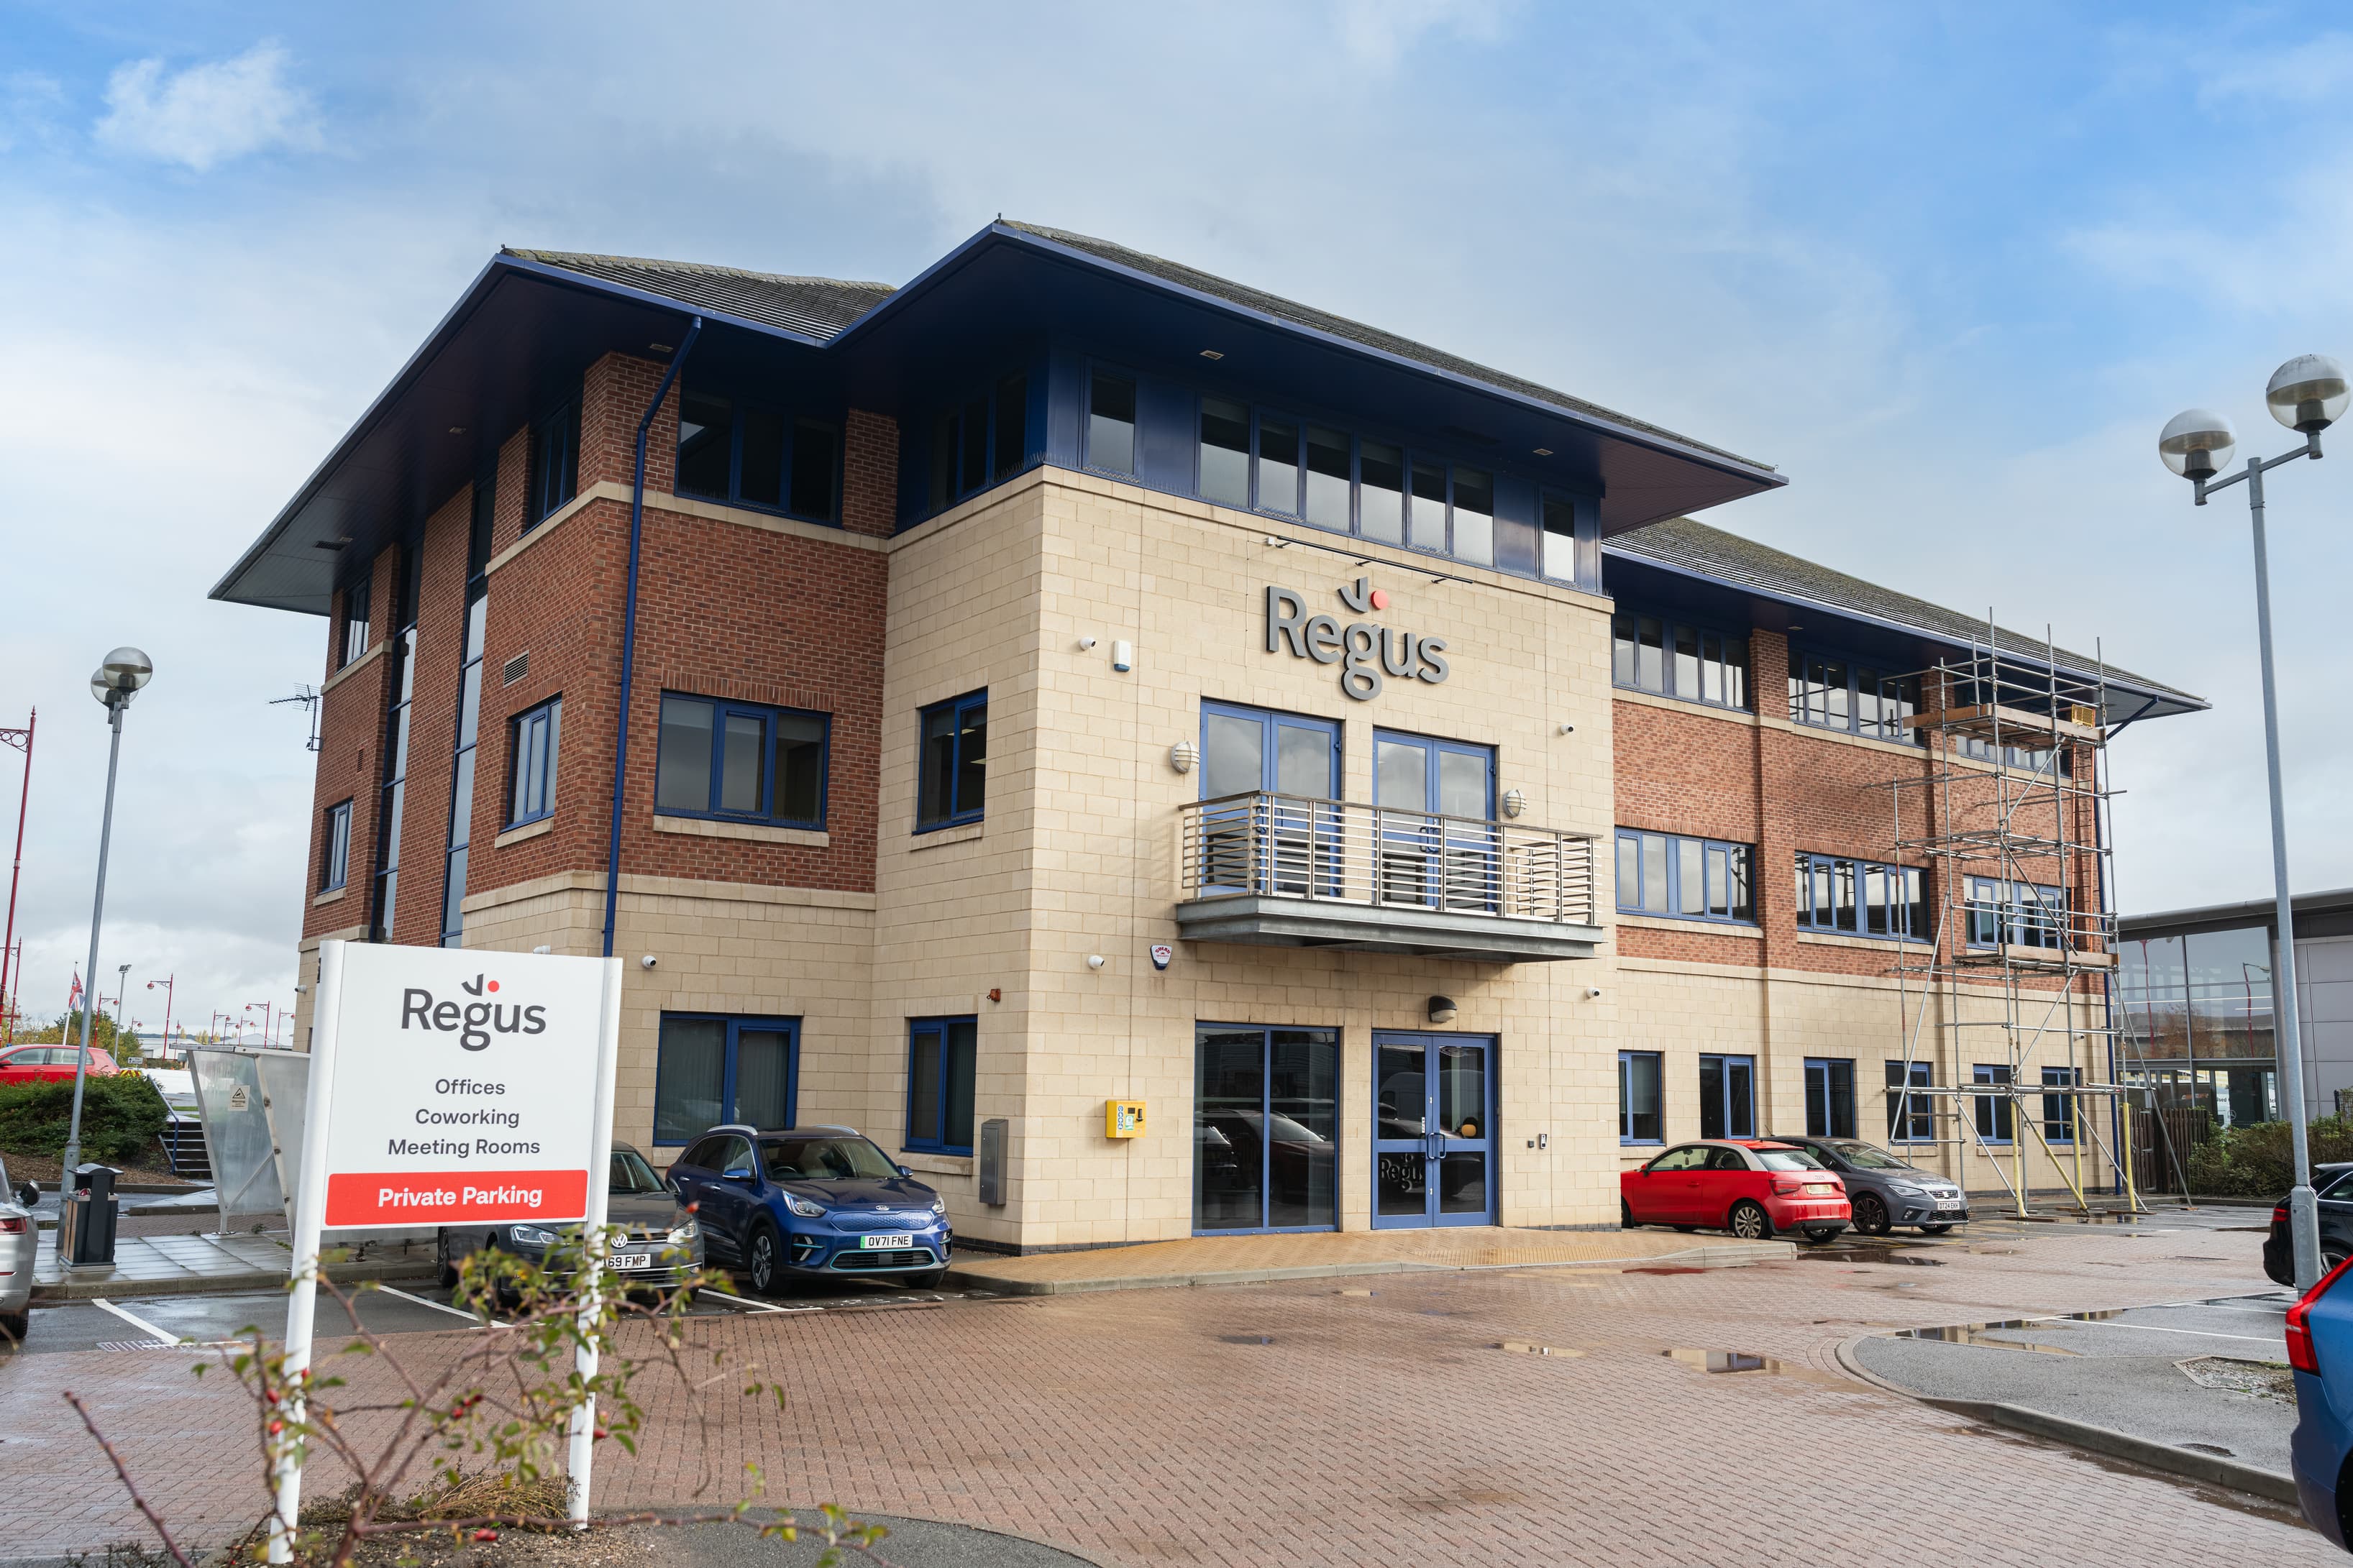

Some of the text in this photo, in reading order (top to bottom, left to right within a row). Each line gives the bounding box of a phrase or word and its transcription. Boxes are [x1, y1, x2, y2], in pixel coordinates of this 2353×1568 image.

[1266, 584, 1449, 700] Regus
[401, 987, 547, 1051] Regus
[435, 1078, 505, 1095] Offices
[416, 1109, 519, 1129] Coworking
[388, 1138, 540, 1159] Meeting Rooms
[378, 1186, 542, 1208] Private Parking
[869, 1236, 909, 1246] OV71 FNE
[626, 1255, 646, 1266] FMP
